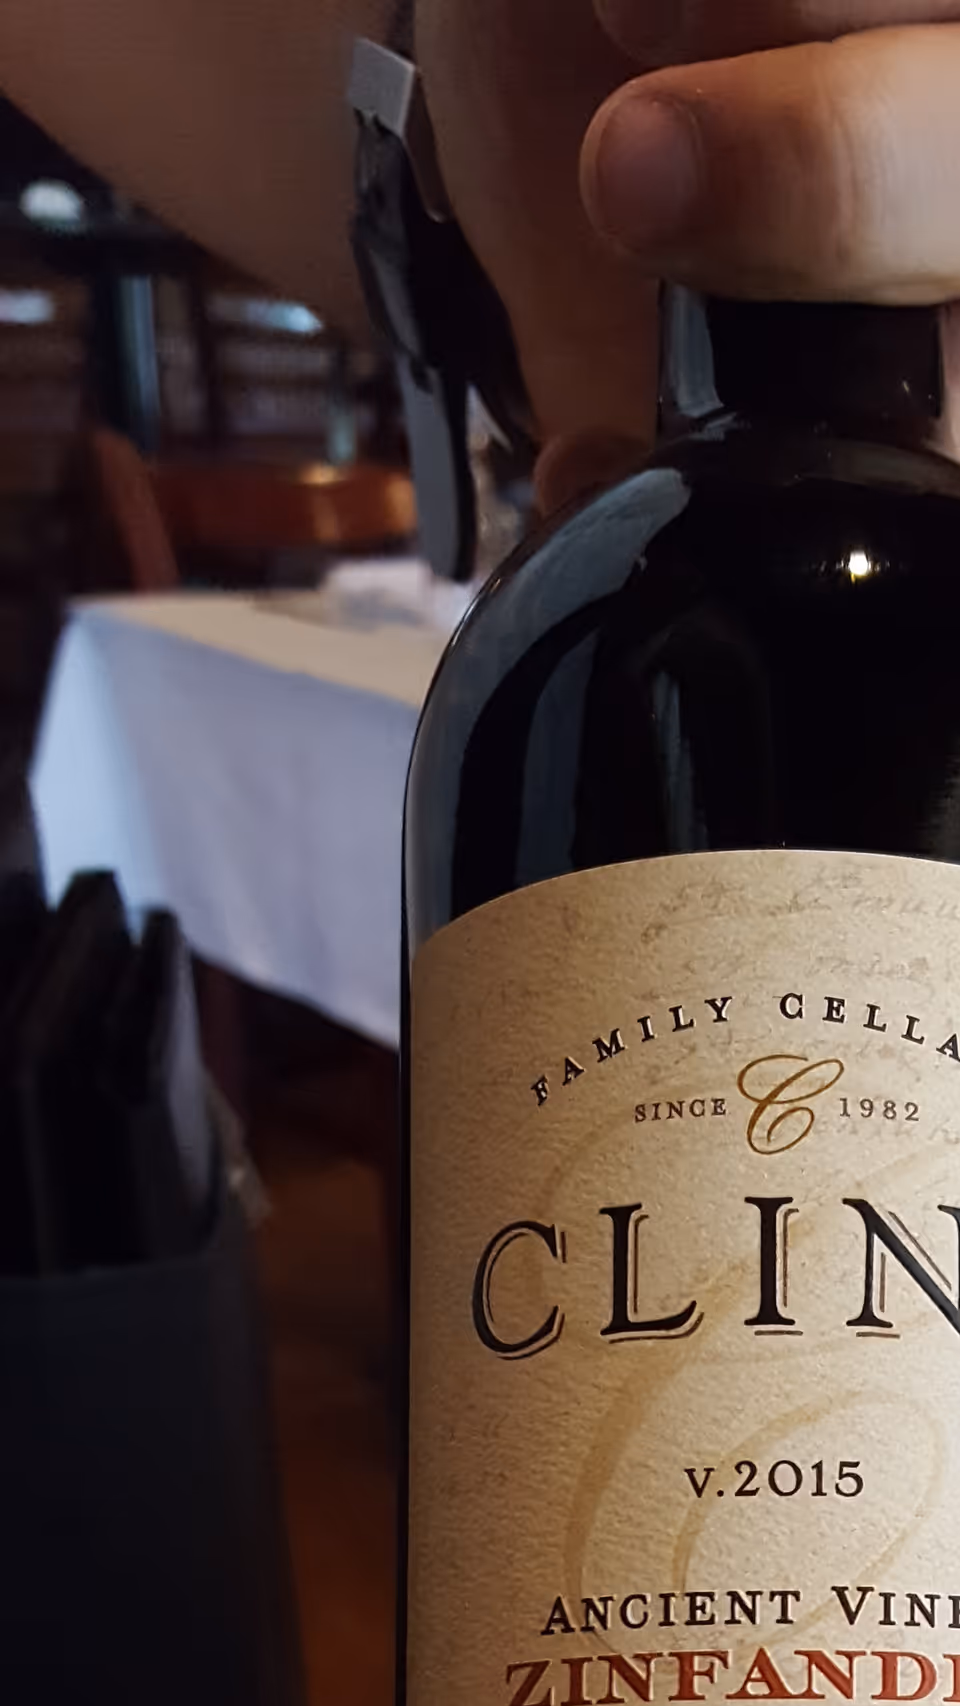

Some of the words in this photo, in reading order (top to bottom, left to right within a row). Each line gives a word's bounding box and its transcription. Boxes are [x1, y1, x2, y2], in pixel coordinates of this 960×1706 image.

[530, 994, 734, 1108] FAMILY
[634, 1097, 727, 1124] SINCE
[838, 1096, 921, 1123] 1982
[539, 1589, 802, 1636] ANCIENT
